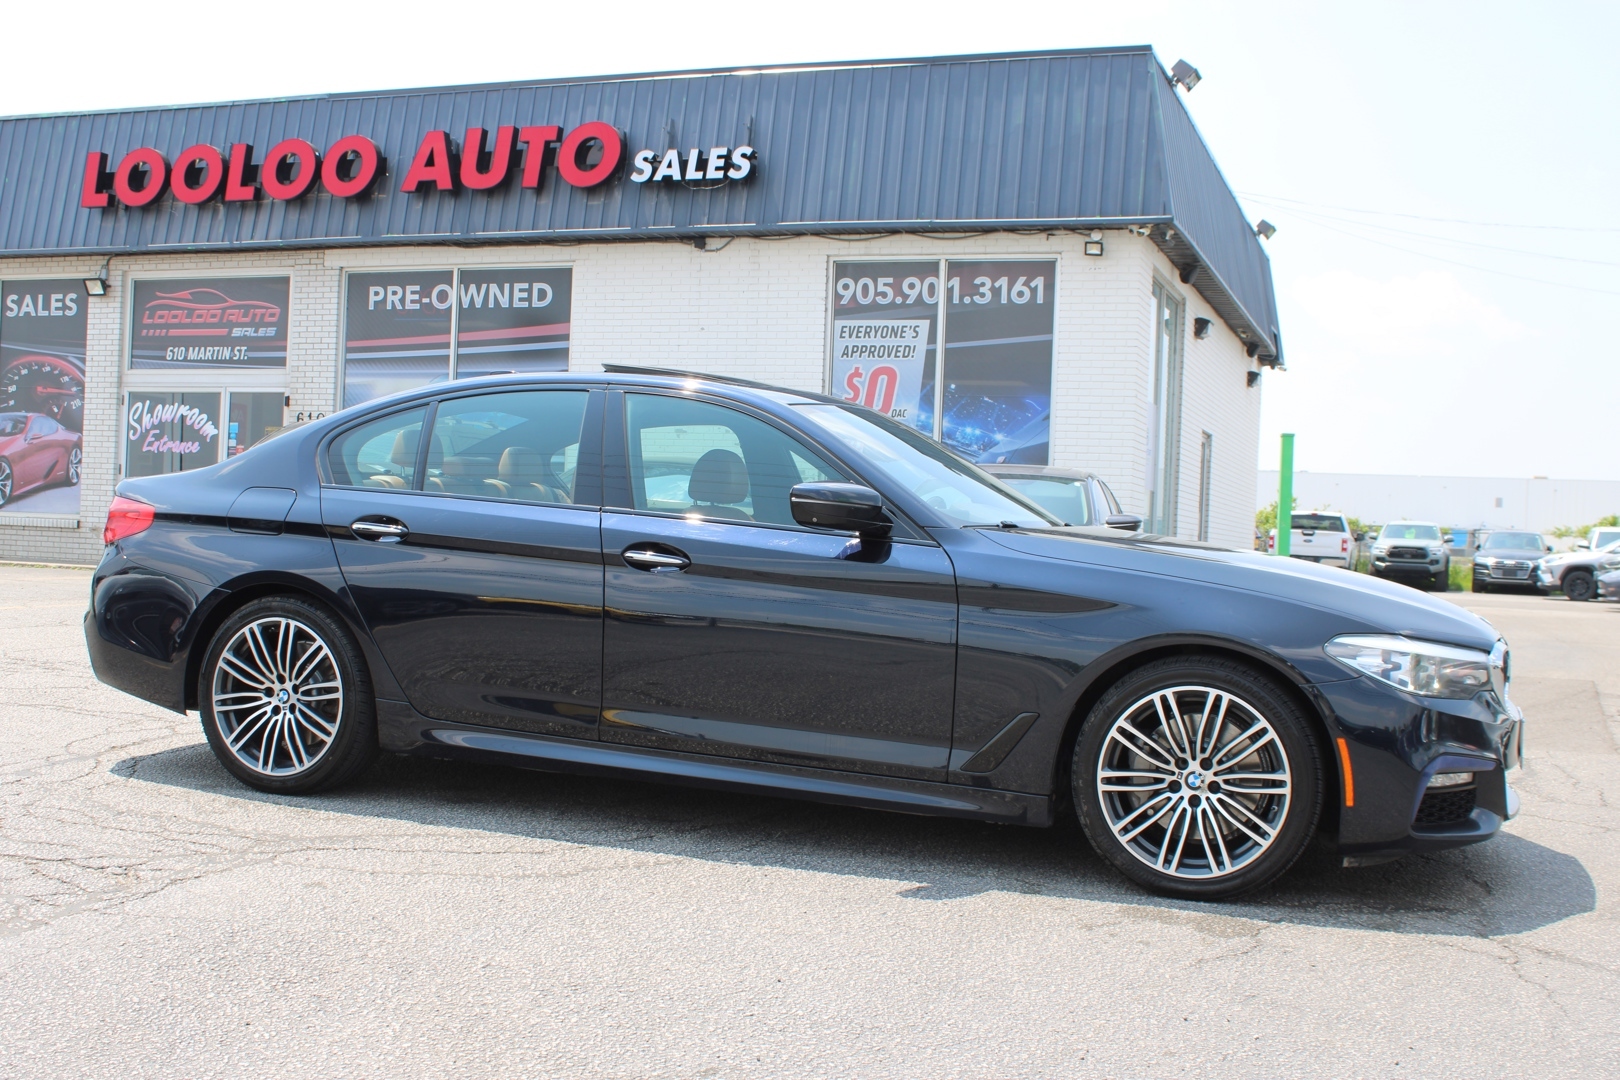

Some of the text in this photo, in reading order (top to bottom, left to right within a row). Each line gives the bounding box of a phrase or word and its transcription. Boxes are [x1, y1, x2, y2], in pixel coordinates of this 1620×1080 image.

[81, 121, 754, 209] LOOLOO AUTO SALES
[368, 282, 553, 311] PRE-OWNED
[836, 275, 1045, 305] 905.901.3161
[5, 293, 78, 318] SALES
[142, 308, 281, 324] LOOLOO AUTO
[231, 327, 277, 337] SALES
[839, 325, 920, 340] EVERYONE'S
[166, 346, 248, 361] 610 MARTIN ST.
[840, 344, 917, 359] APPROVED!
[129, 400, 218, 442] Showroom
[142, 429, 200, 454] Entrance
